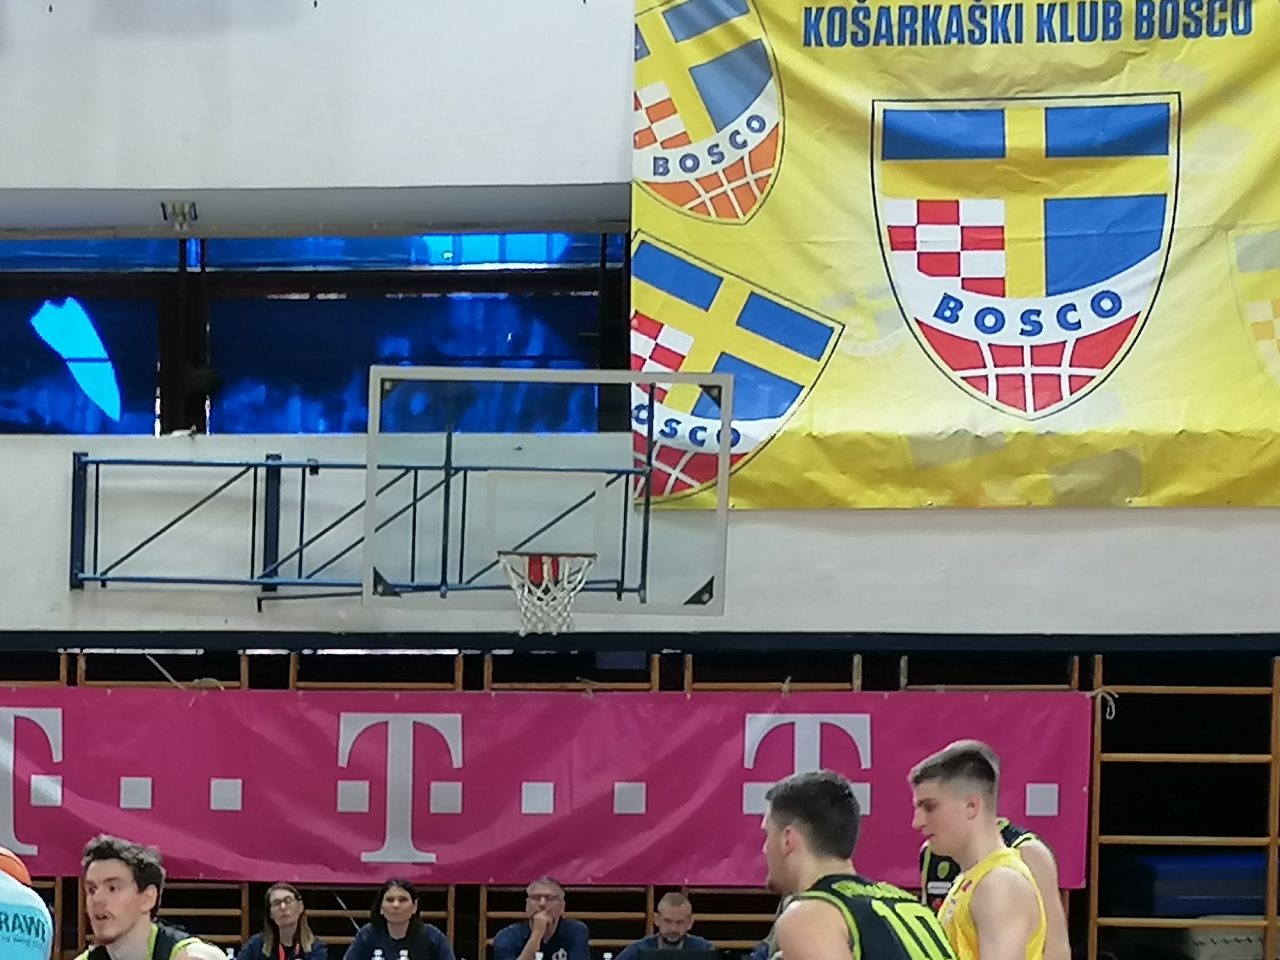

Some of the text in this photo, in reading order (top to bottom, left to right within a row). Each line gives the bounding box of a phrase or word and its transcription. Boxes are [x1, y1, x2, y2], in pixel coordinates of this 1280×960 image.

[803, 0, 1253, 47] KOŠARKAŠKI KLUB BOSCO
[653, 114, 767, 177] BOSCO
[932, 290, 1123, 337] BOSCO
[631, 403, 741, 448] OSCO
[337, 713, 462, 863] T
